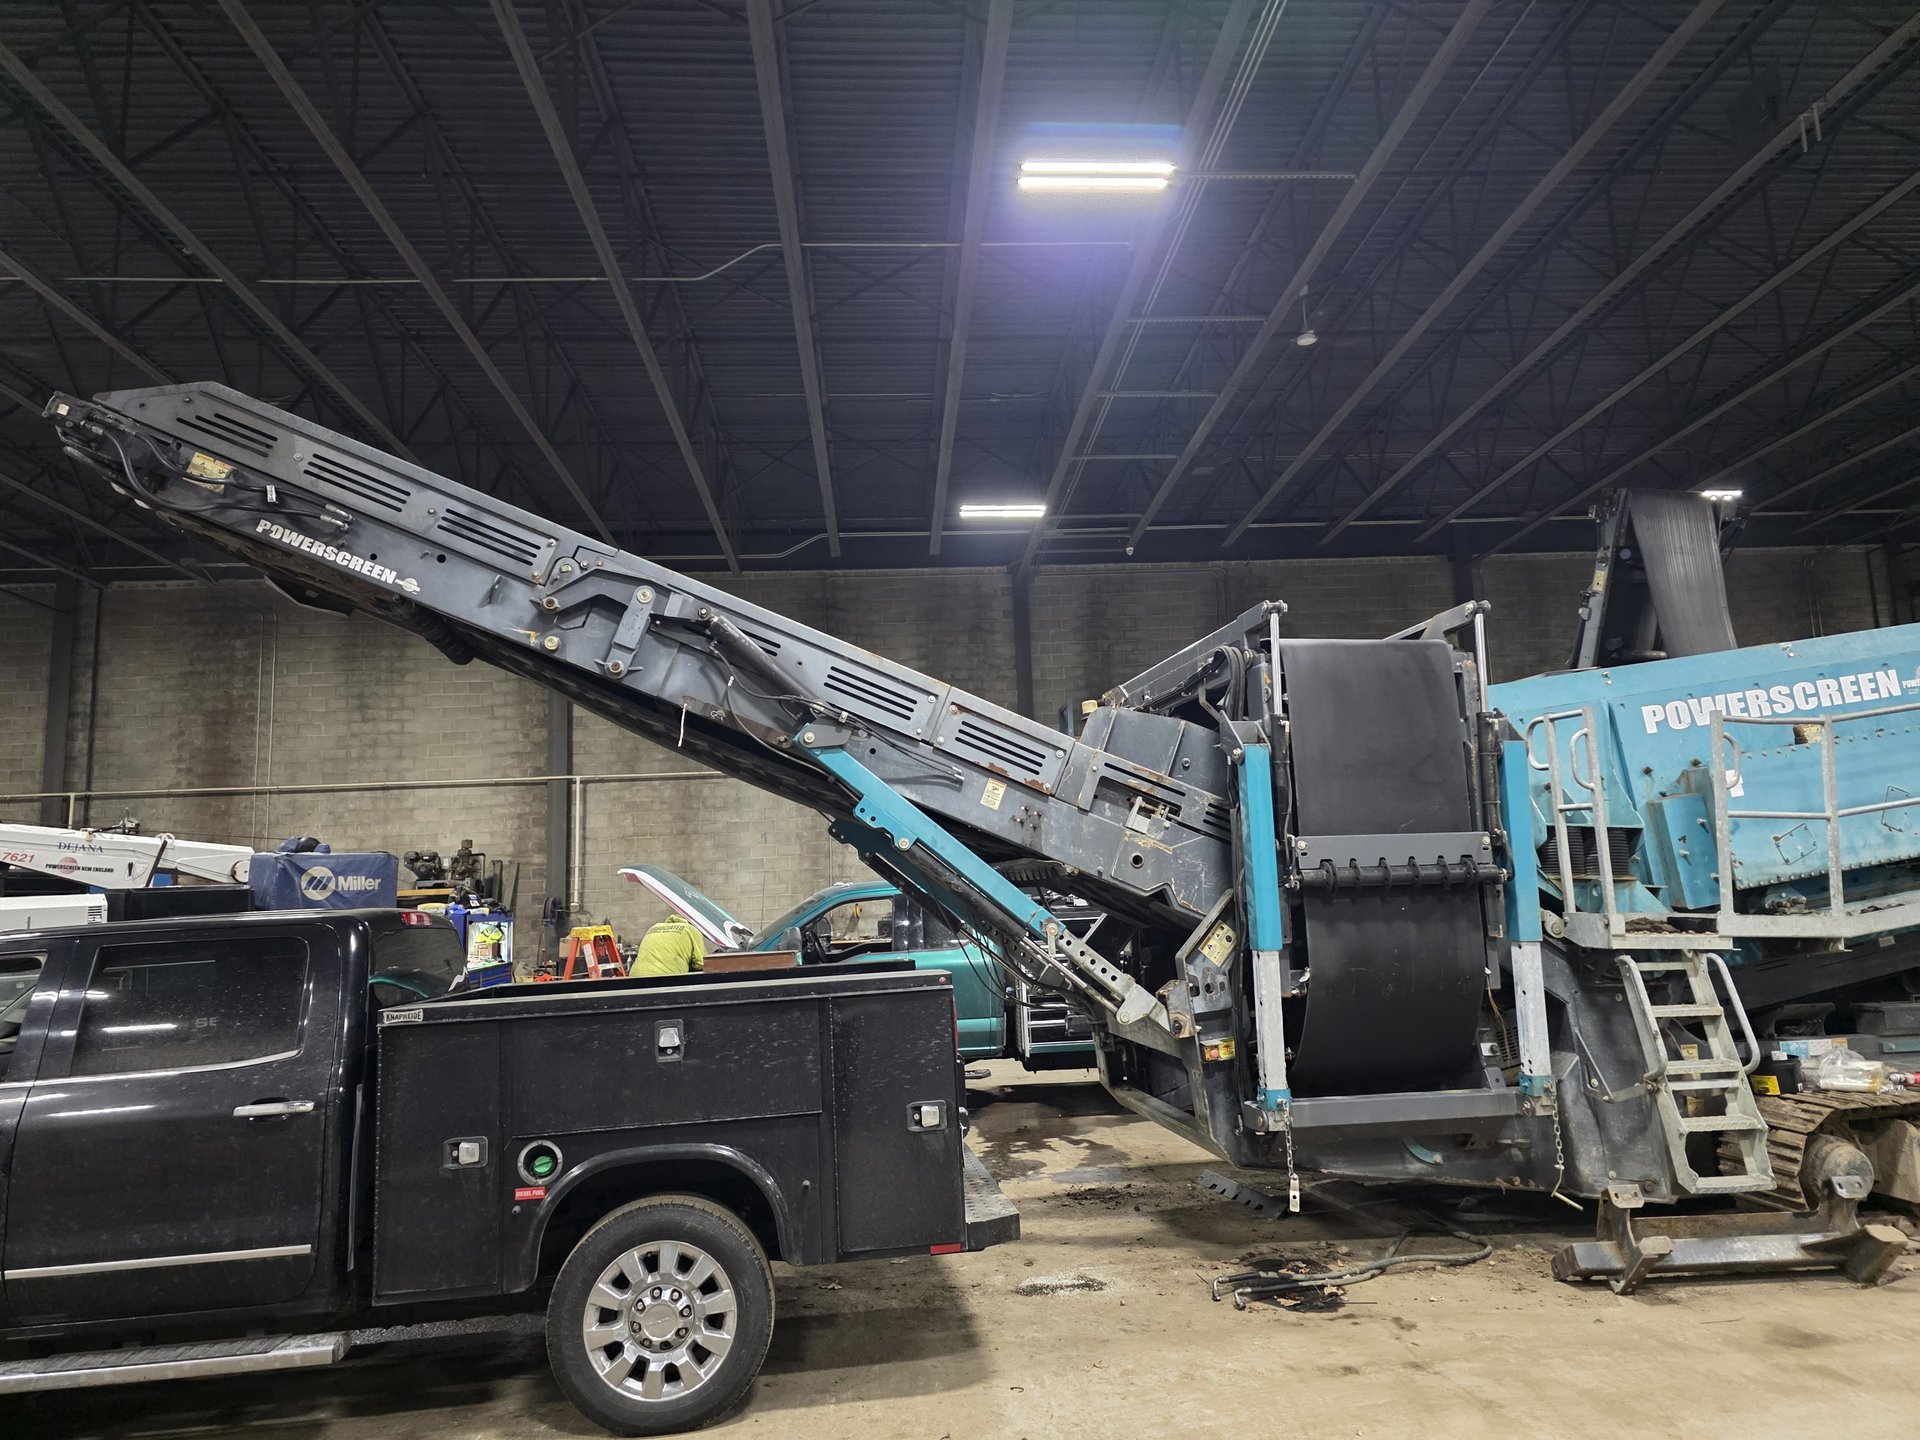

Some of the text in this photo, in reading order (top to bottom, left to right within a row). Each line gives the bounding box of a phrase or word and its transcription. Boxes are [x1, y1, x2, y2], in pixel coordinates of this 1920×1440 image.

[256, 519, 397, 584] POWERSCREEN
[1641, 669, 1902, 734] POWERSCREEN
[57, 842, 103, 853] DEJANA
[2, 852, 35, 863] 7621
[45, 863, 81, 871] POWERSCREEN
[338, 875, 381, 891] Miller
